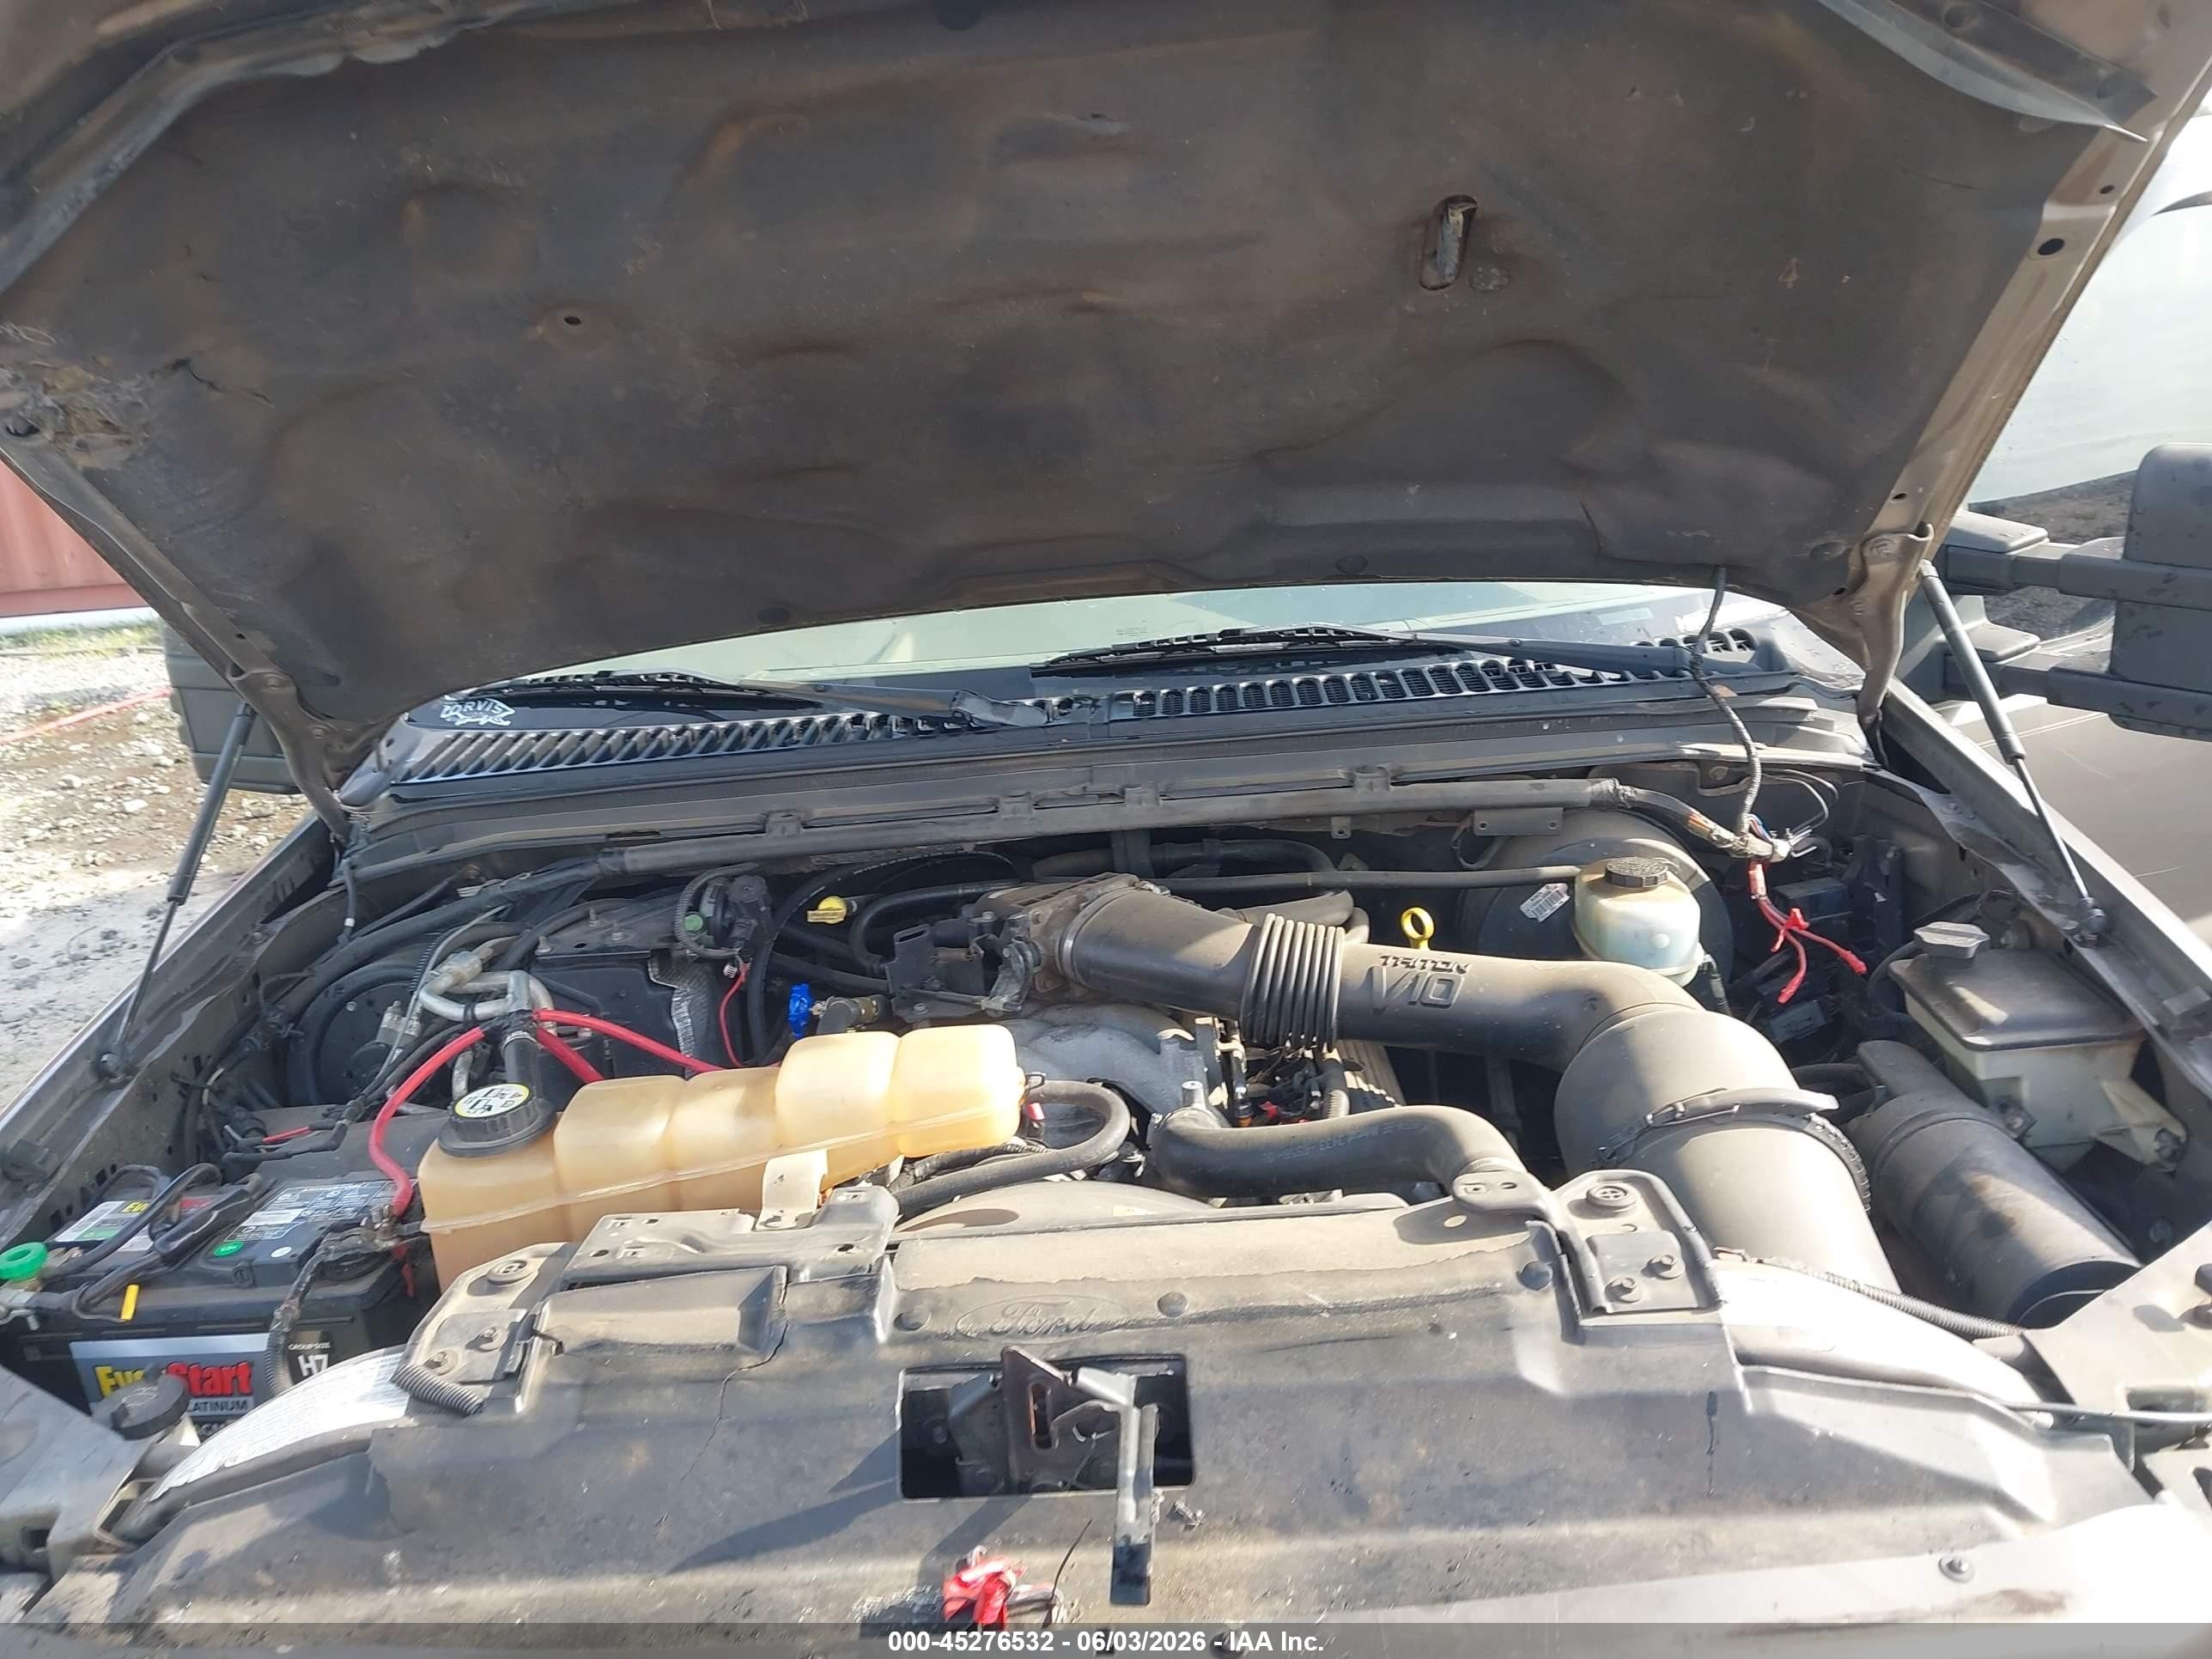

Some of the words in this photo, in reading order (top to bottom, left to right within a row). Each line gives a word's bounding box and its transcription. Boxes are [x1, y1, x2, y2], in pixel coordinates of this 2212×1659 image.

[1379, 955, 1469, 975] TRITON
[1370, 965, 1462, 1013] V10
[989, 1299, 1096, 1335] Ford
[297, 1353, 329, 1376] H7
[187, 1400, 249, 1413] ATINUM
